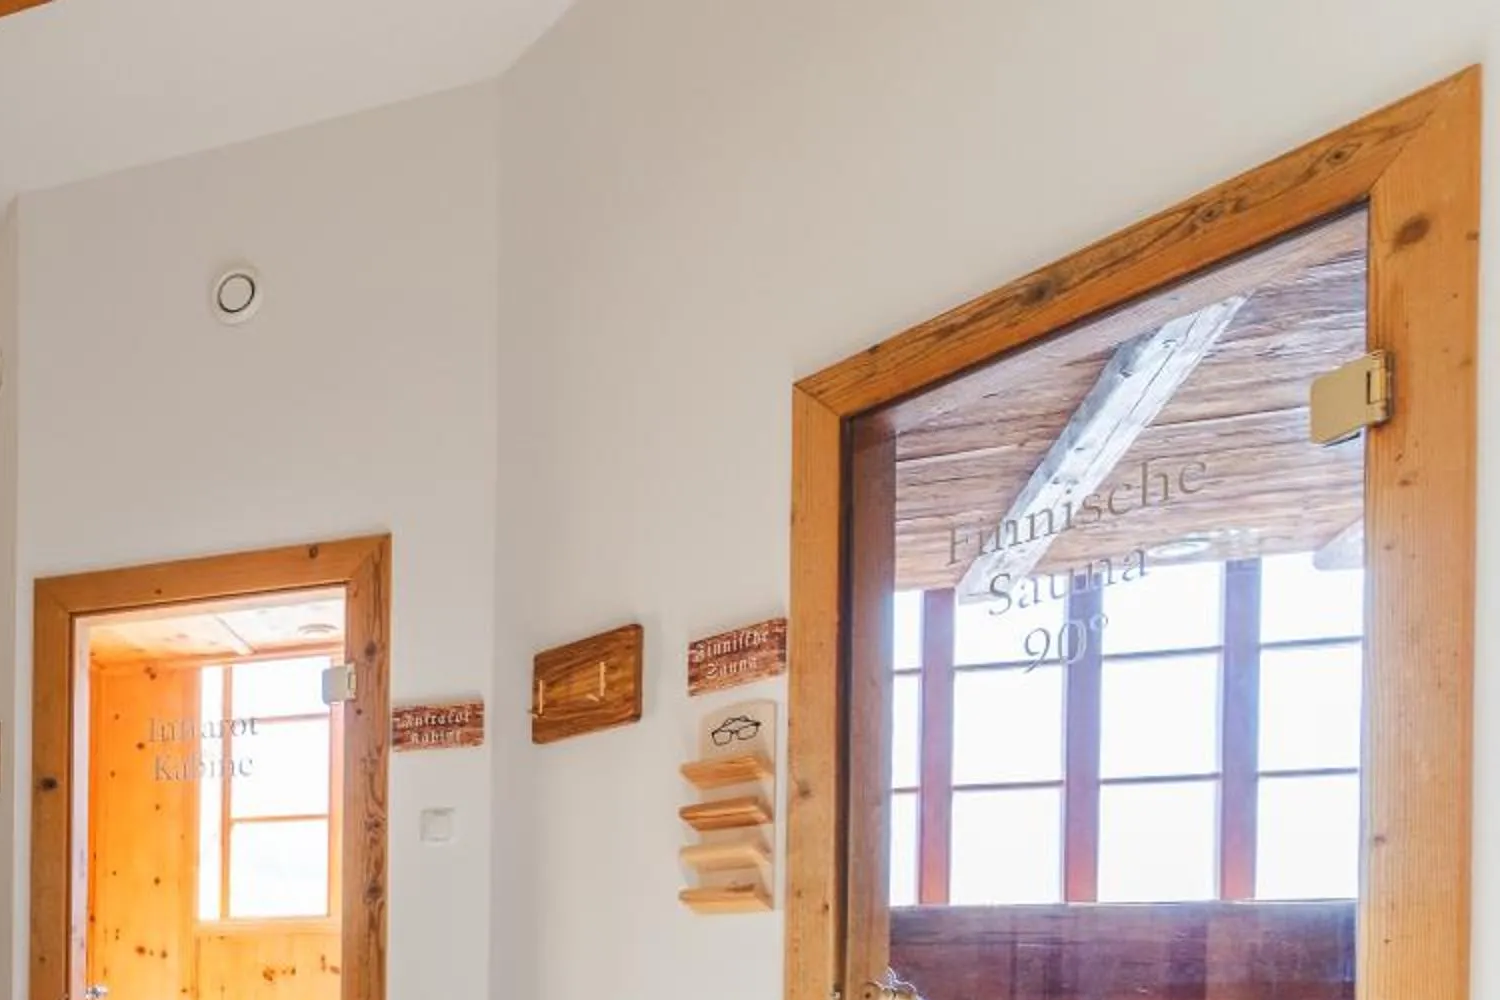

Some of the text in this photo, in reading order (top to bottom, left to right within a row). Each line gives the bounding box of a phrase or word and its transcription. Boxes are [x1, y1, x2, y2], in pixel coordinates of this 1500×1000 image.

[946, 461, 1207, 567] Finnische
[988, 548, 1149, 616] Sauna
[692, 627, 769, 663] Finnische
[1023, 612, 1109, 673] 90°
[706, 656, 758, 679] Sauna
[148, 716, 259, 743] Infrarot
[155, 754, 254, 781] Kabine
